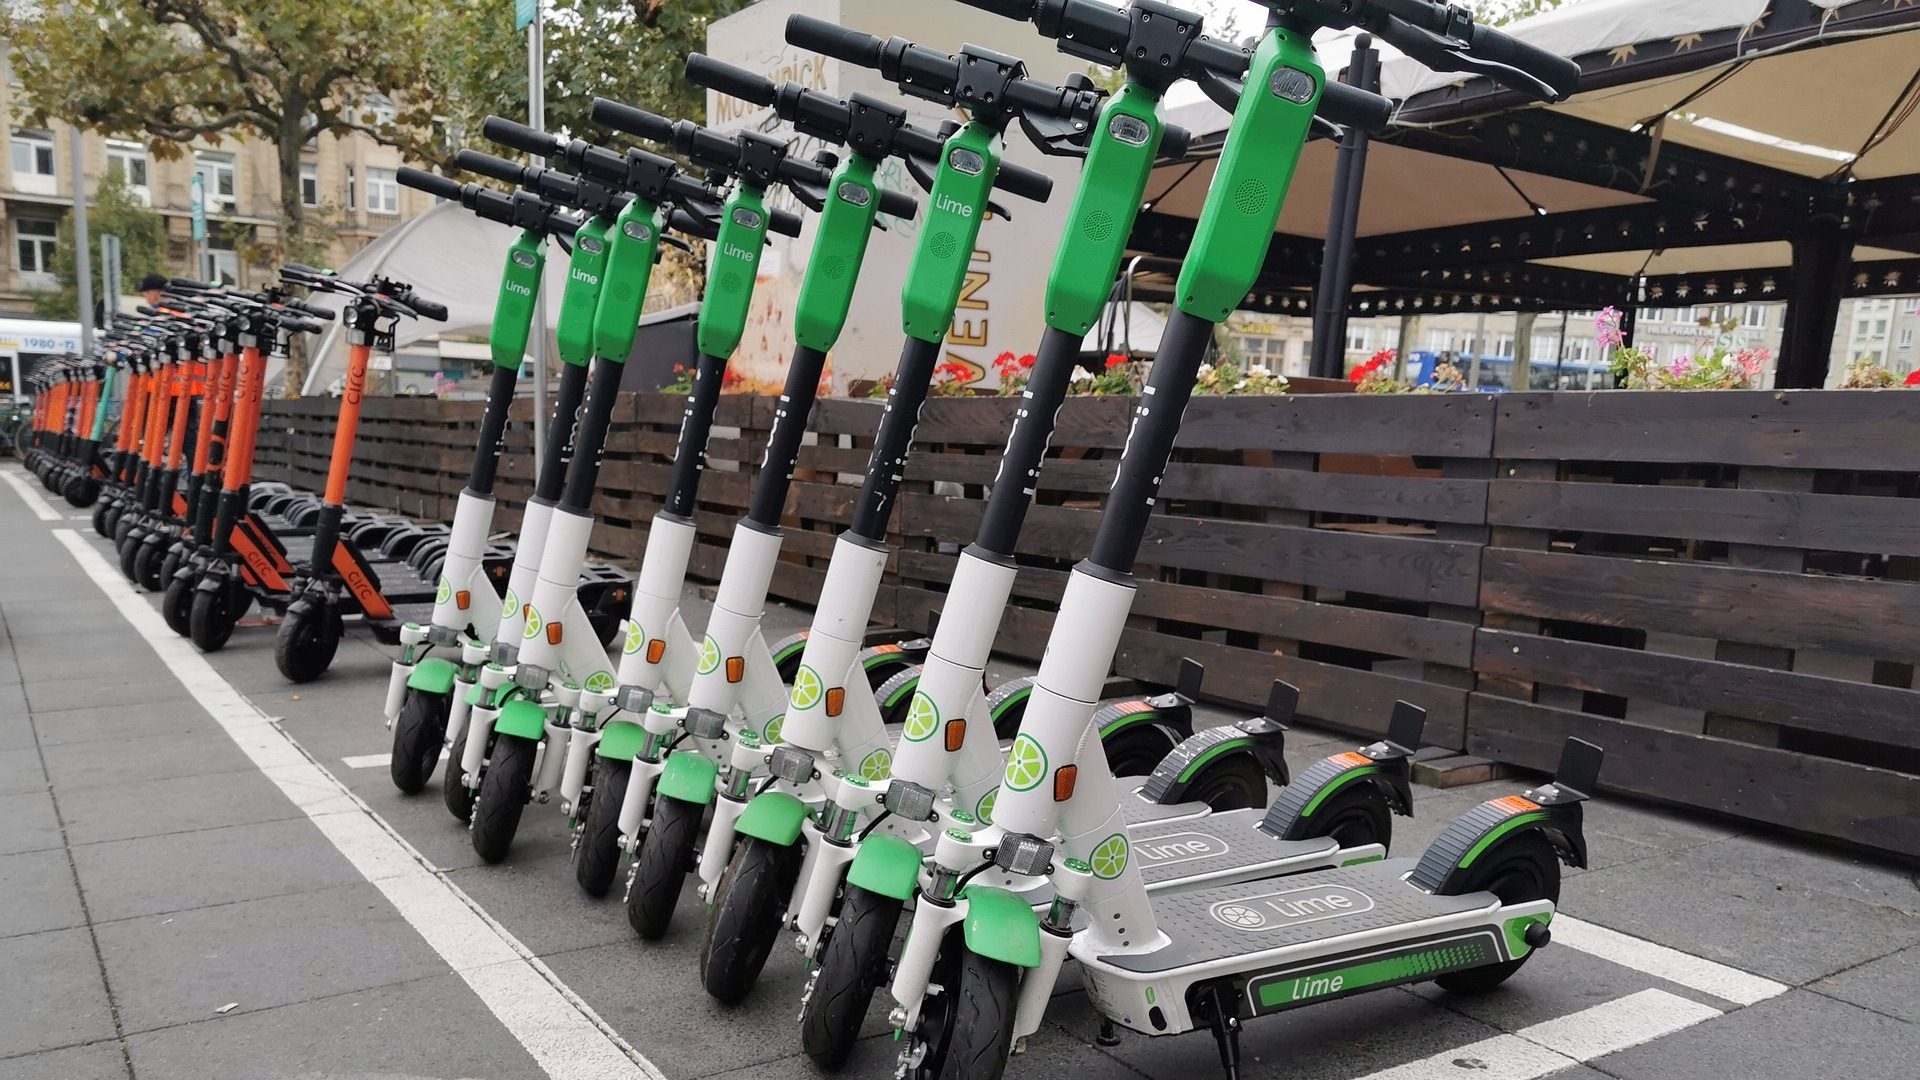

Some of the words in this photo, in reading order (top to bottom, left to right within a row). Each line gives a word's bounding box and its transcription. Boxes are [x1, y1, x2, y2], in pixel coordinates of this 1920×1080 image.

[936, 193, 973, 217] Lime
[723, 243, 754, 262] Lime
[505, 279, 531, 296] Lime
[571, 267, 598, 285] Lime
[347, 366, 365, 405] circ
[248, 551, 271, 577] circ
[348, 570, 372, 600] circ
[1133, 840, 1211, 860] Lime
[1265, 894, 1353, 918] Lime
[1292, 975, 1344, 1000] Lime
